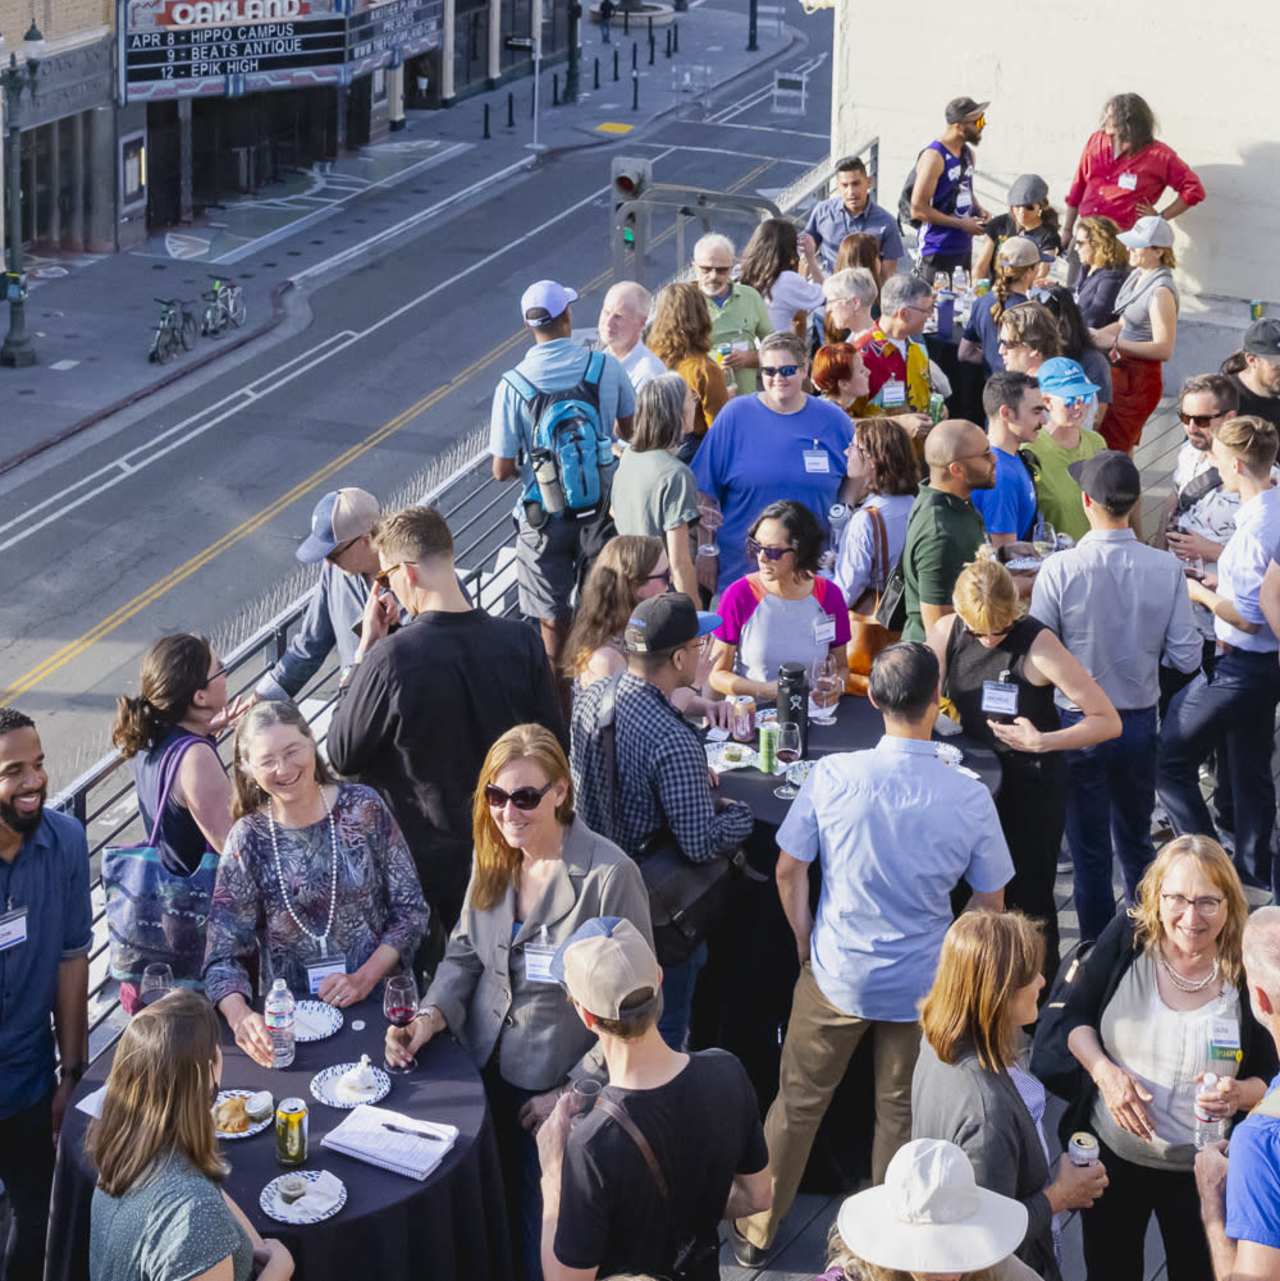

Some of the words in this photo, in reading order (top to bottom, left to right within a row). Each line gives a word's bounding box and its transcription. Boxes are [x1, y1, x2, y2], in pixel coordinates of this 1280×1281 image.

[132, 34, 161, 48] APR
[167, 32, 175, 46] 8
[191, 29, 232, 44] HIPPO
[237, 23, 294, 40] CAMPUS
[167, 49, 175, 63] 9
[191, 44, 238, 60] BEATS
[243, 38, 302, 56] ANTIQUE
[161, 66, 174, 80] 12
[191, 63, 221, 77] EPIK
[227, 60, 259, 73] HIGH
